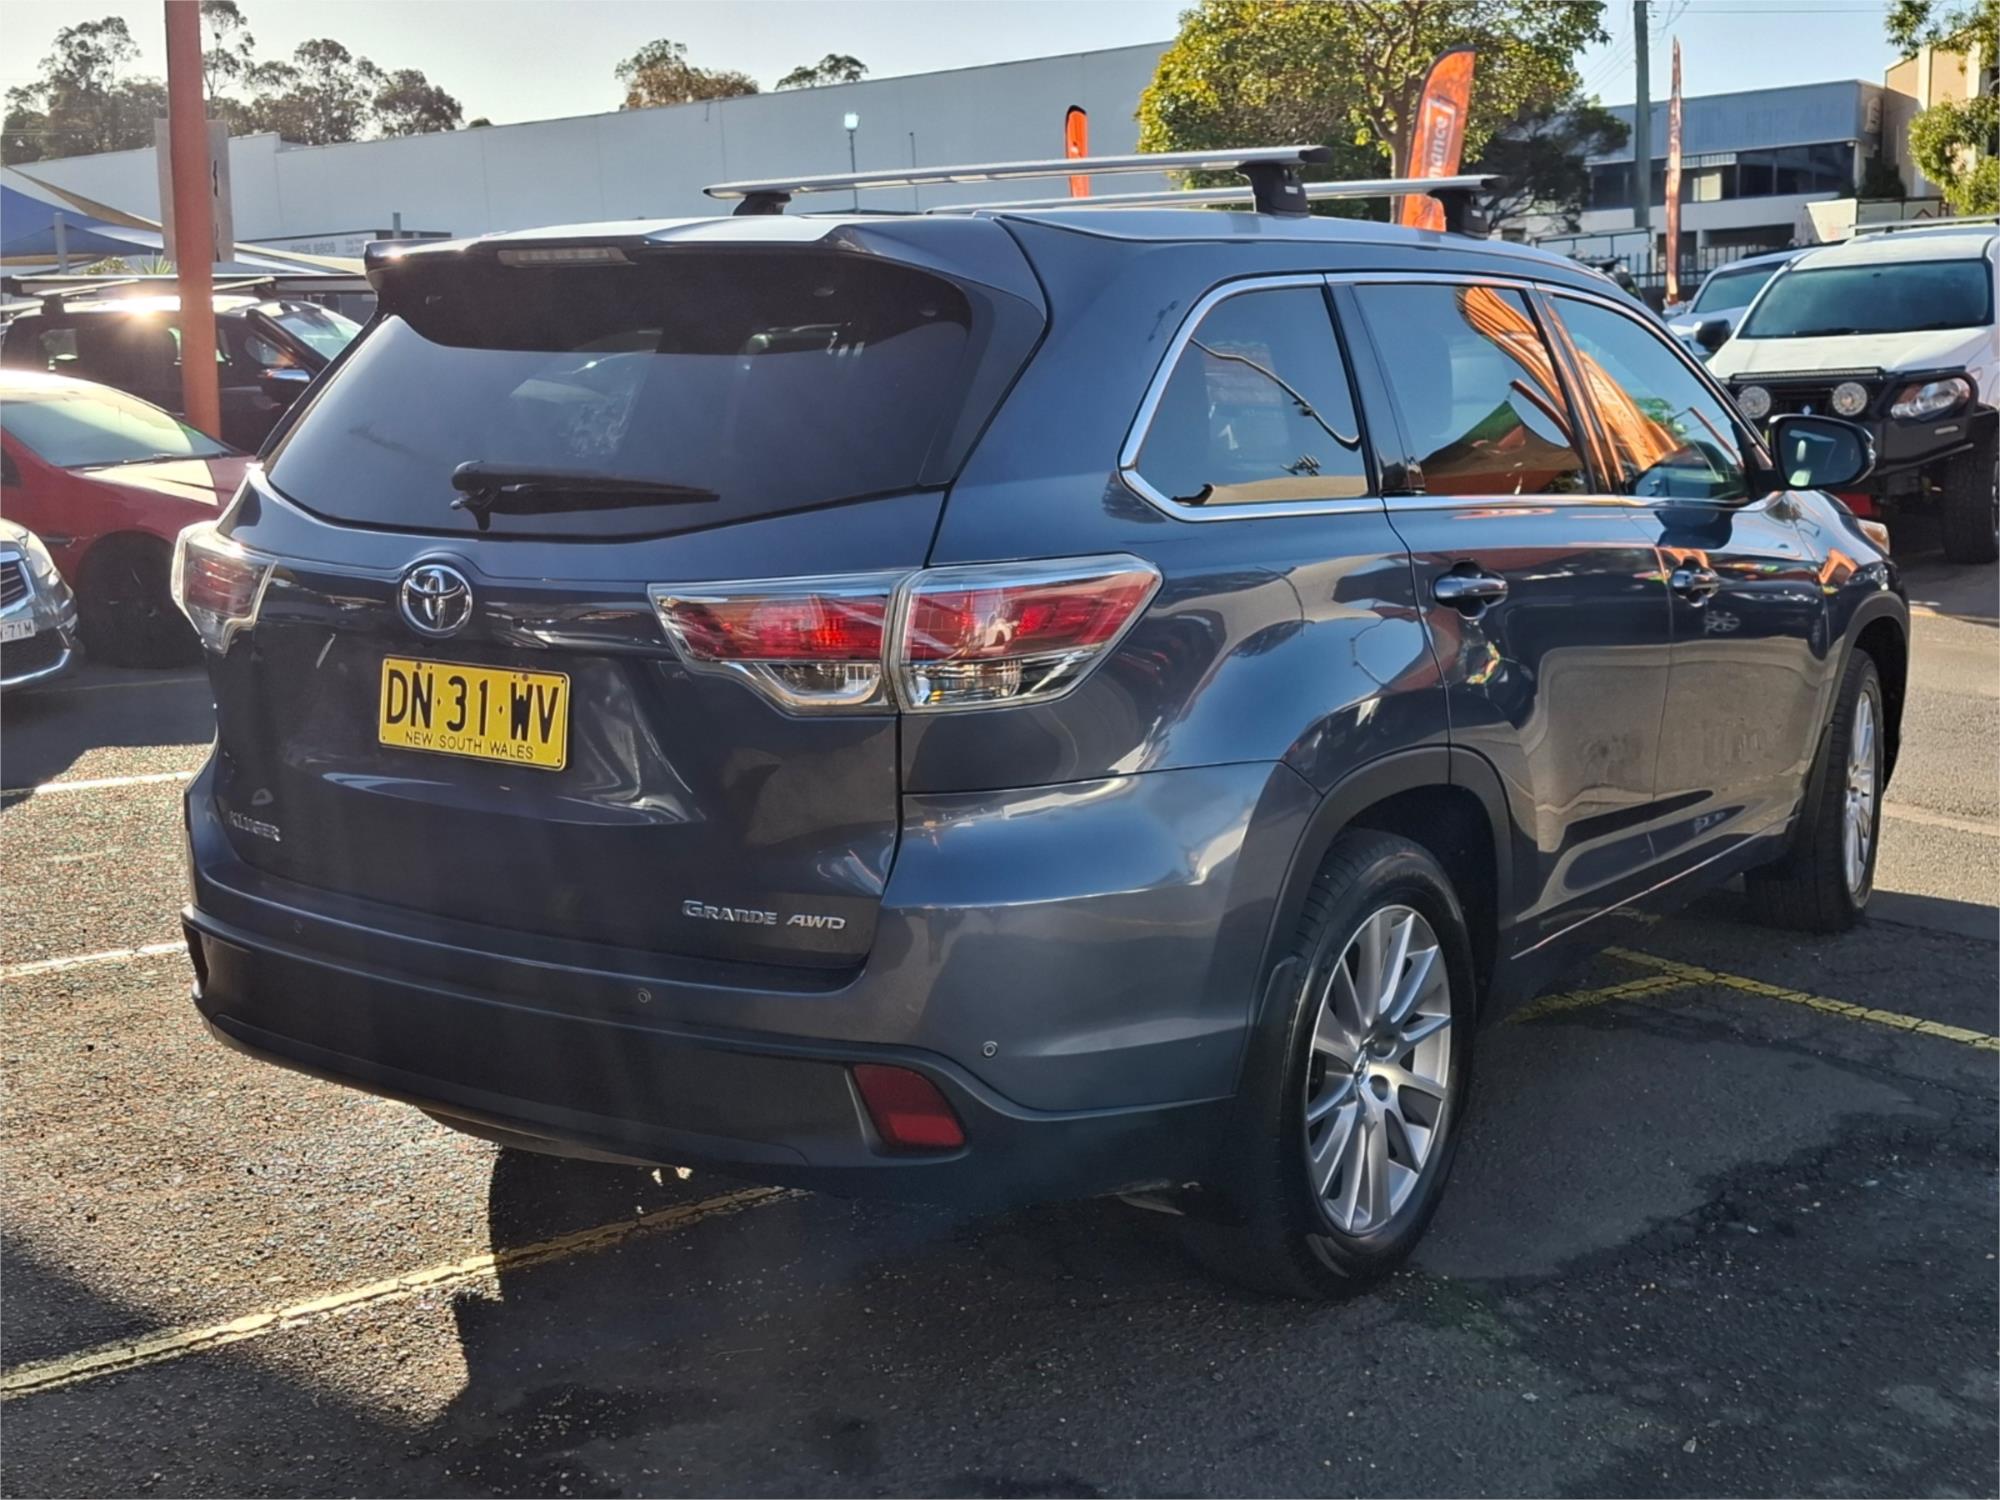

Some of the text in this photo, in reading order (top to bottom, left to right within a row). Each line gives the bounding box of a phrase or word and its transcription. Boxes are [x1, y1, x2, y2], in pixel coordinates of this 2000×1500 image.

[1428, 115, 1450, 178] nance
[405, 731, 534, 760] NEW SOUTH WALES
[682, 899, 846, 930] GRANDE AWD
